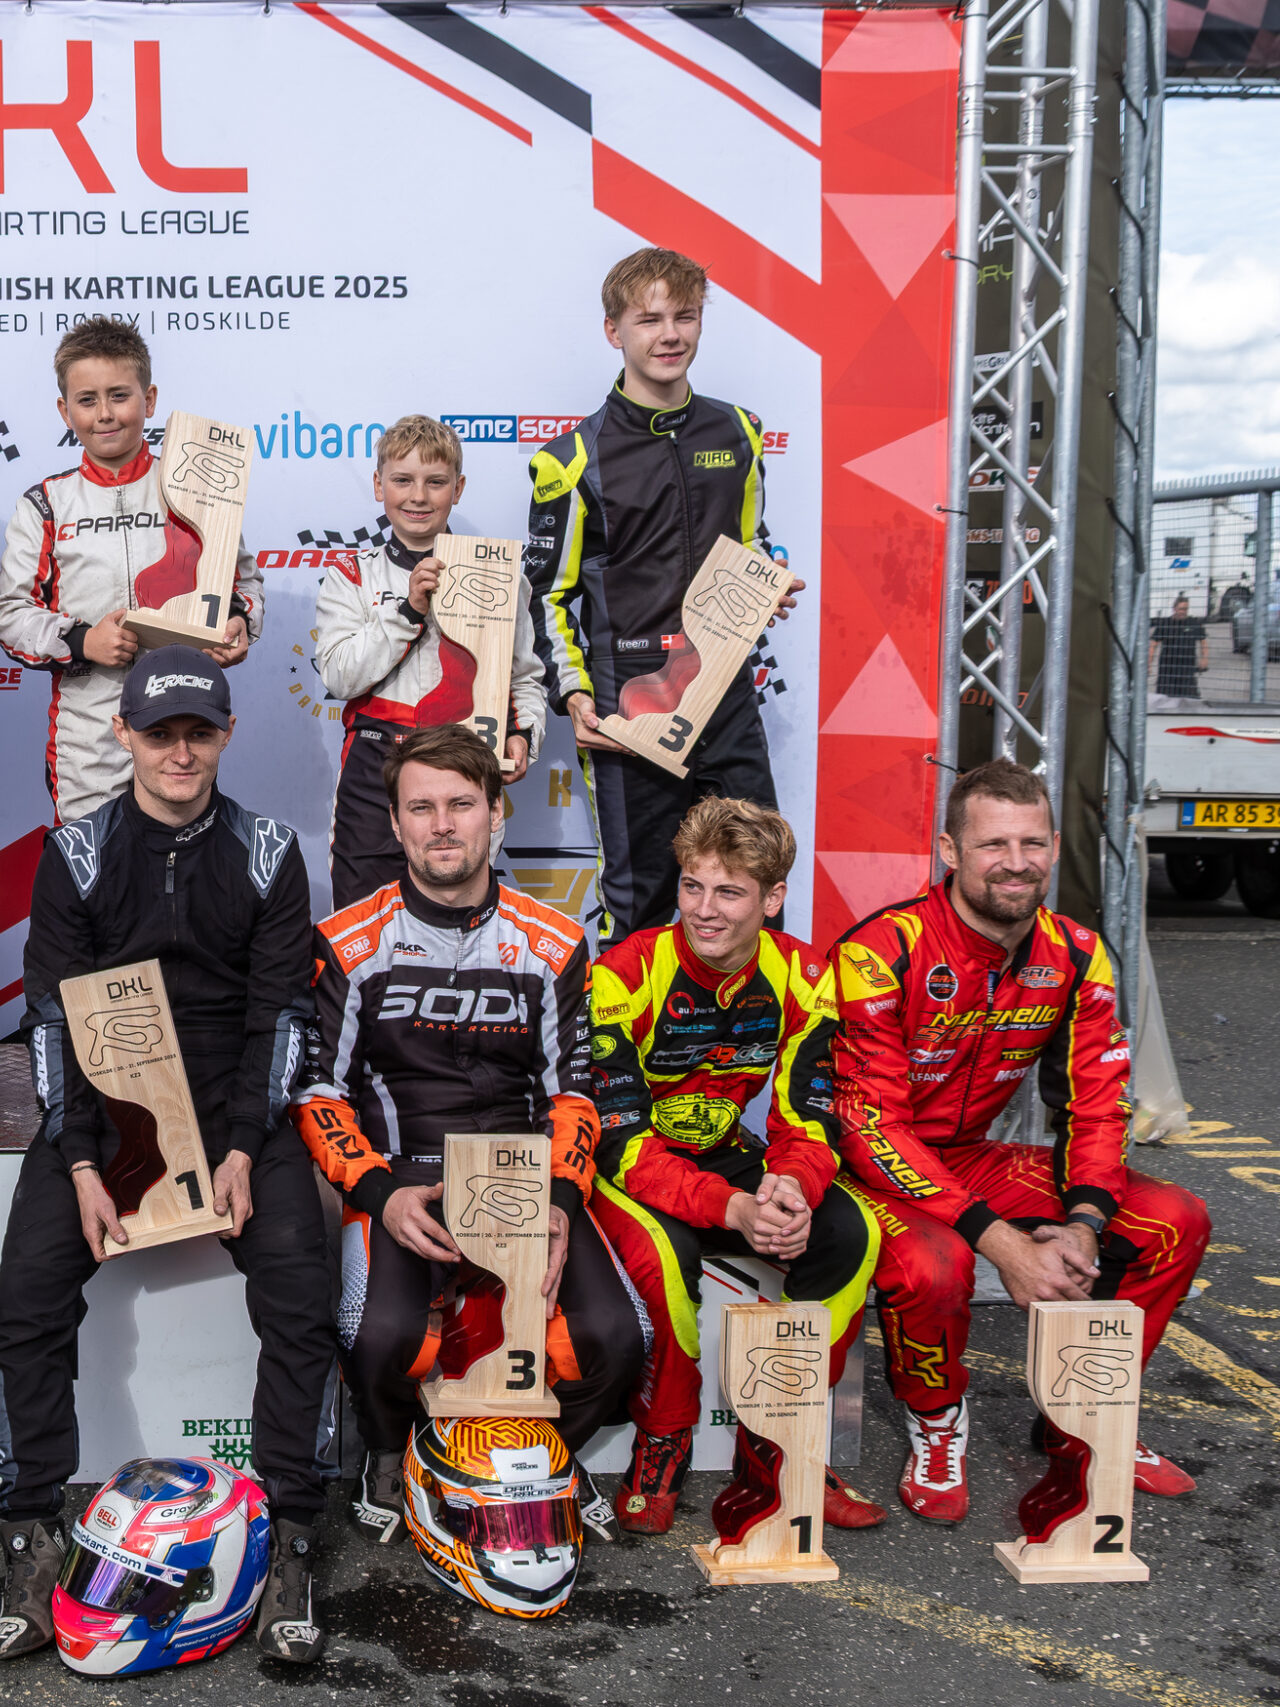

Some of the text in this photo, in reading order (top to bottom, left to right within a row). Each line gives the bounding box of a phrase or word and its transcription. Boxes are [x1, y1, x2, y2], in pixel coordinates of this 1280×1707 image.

[121, 209, 249, 235] LEAGUE
[64, 276, 198, 300] KARTING
[208, 275, 325, 299] LEAGUE
[334, 275, 409, 299] 2025
[167, 311, 291, 331] ROSKILDE
[208, 425, 246, 449] DKL
[475, 543, 513, 562] DKL
[745, 559, 779, 589] DKL
[201, 593, 221, 629] 1
[617, 639, 649, 651] freem
[474, 715, 499, 750] 3
[657, 714, 694, 753] 3
[1201, 804, 1280, 824] AR 85 3
[342, 937, 371, 960] OMP
[536, 939, 565, 959] OMP
[106, 975, 153, 1000] DKL
[596, 1002, 631, 1020] freem
[468, 1024, 528, 1035] RACING
[88, 1068, 113, 1077] ROSKILDE
[136, 1057, 163, 1067] SEPTEMBER
[496, 1149, 541, 1167] DKL
[174, 1170, 204, 1210] 1
[776, 1320, 820, 1338] DKL
[1089, 1319, 1133, 1337] DKL
[505, 1349, 536, 1391] 3
[182, 1418, 253, 1437] BEKI
[97, 1508, 117, 1527] BELL
[789, 1515, 813, 1554] 1
[1093, 1514, 1125, 1553] 2
